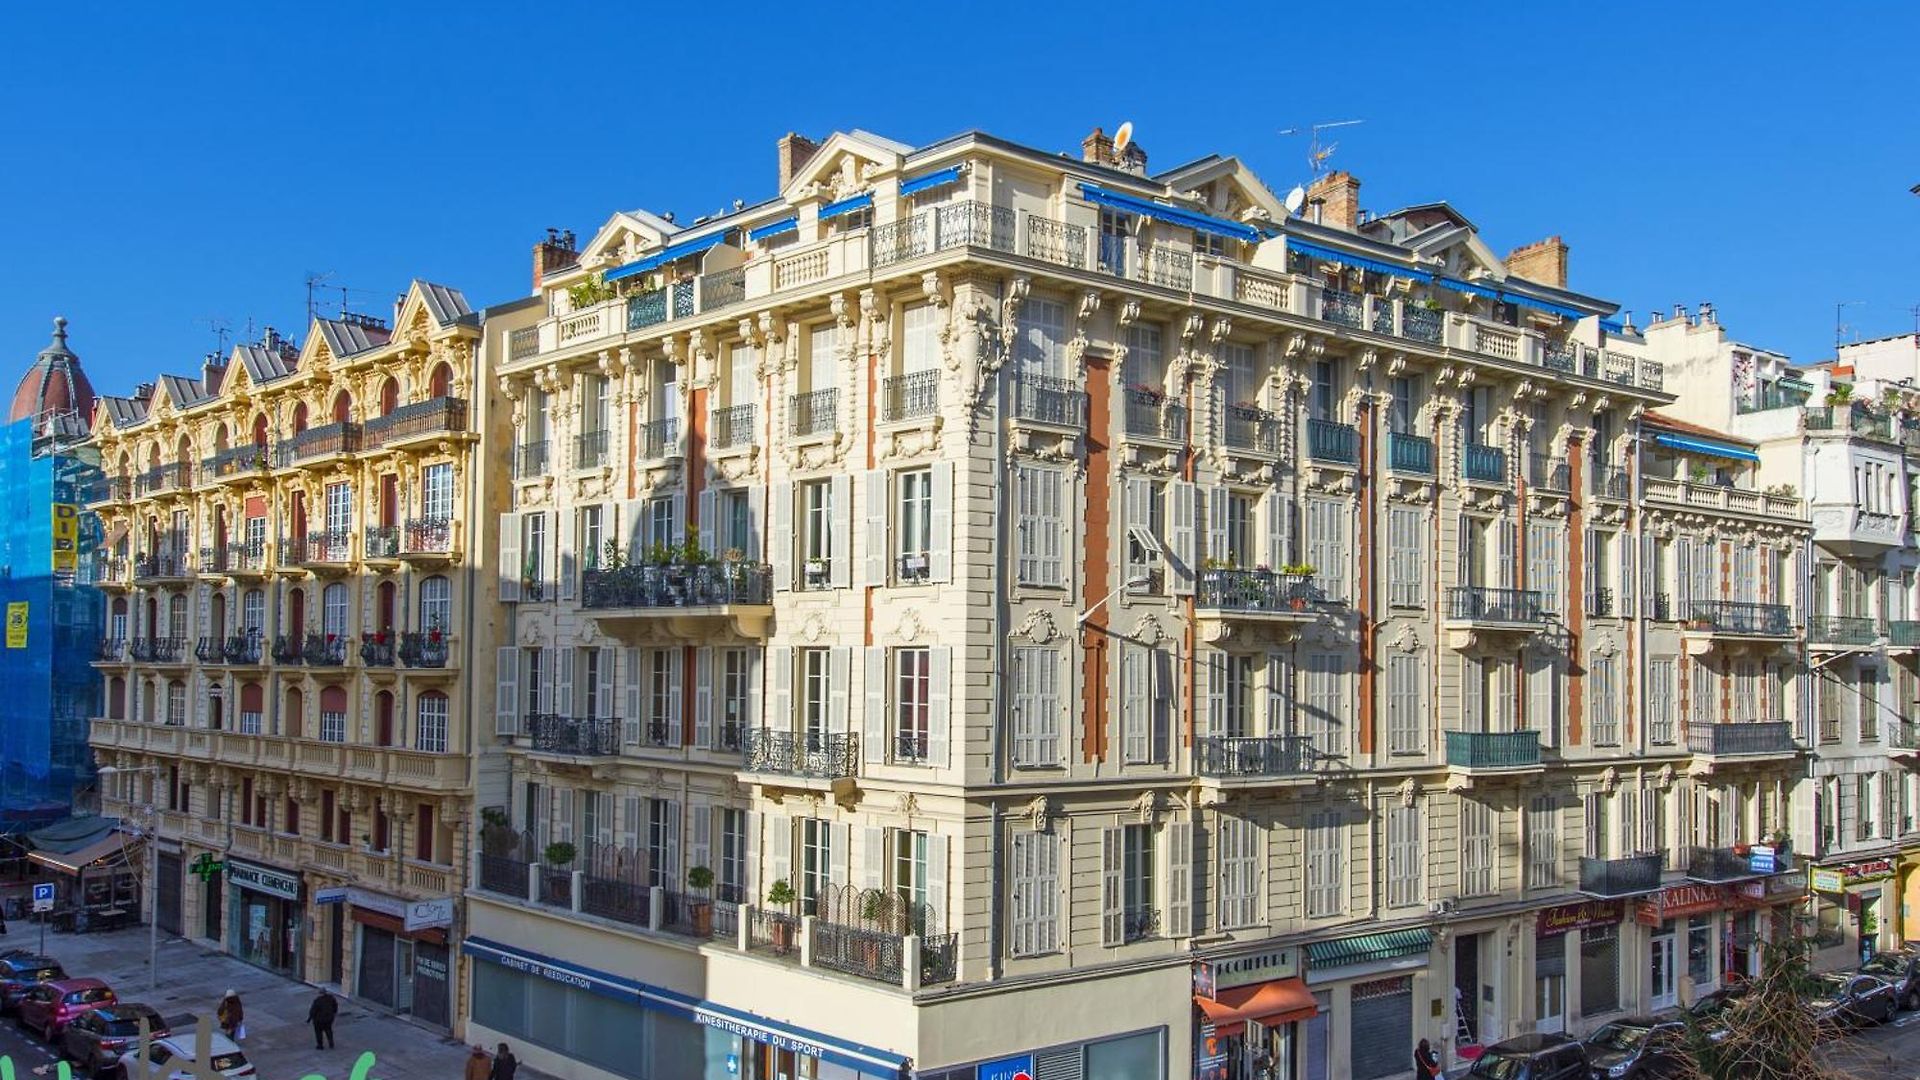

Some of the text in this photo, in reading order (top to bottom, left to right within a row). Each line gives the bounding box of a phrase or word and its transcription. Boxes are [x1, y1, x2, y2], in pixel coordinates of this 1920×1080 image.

[39, 887, 48, 898] P
[1662, 885, 1717, 908] KALINKA
[501, 955, 528, 970] CABINET
[531, 964, 540, 975] DE
[695, 1012, 824, 1058] KINESITHERAPIE DU SPORT
